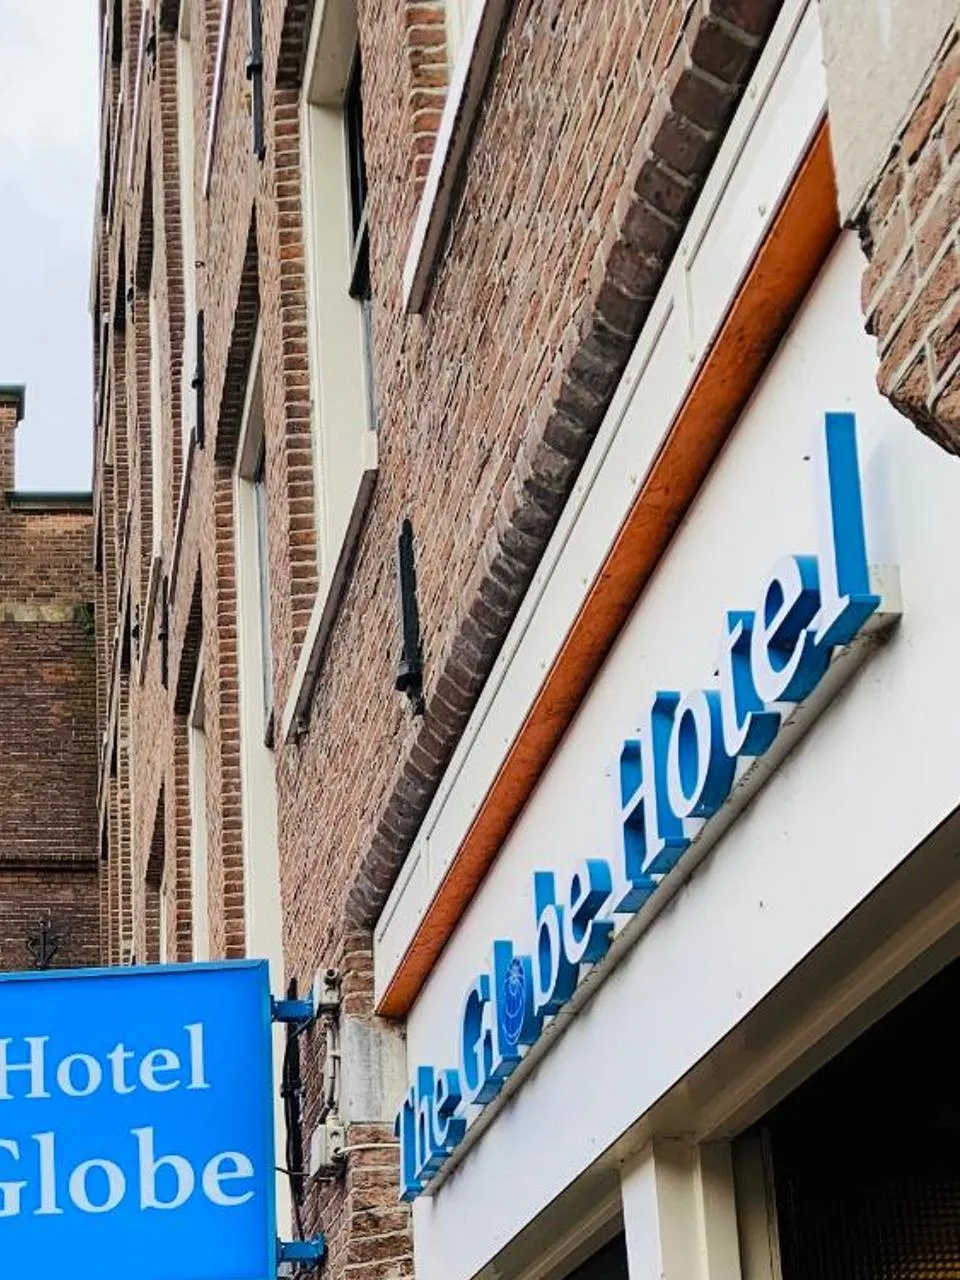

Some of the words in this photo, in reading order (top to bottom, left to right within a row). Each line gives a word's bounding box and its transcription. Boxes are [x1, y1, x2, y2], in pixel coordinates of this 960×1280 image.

[394, 1065, 467, 1201] The
[460, 863, 615, 1104] Globe
[613, 411, 882, 914] Hotel
